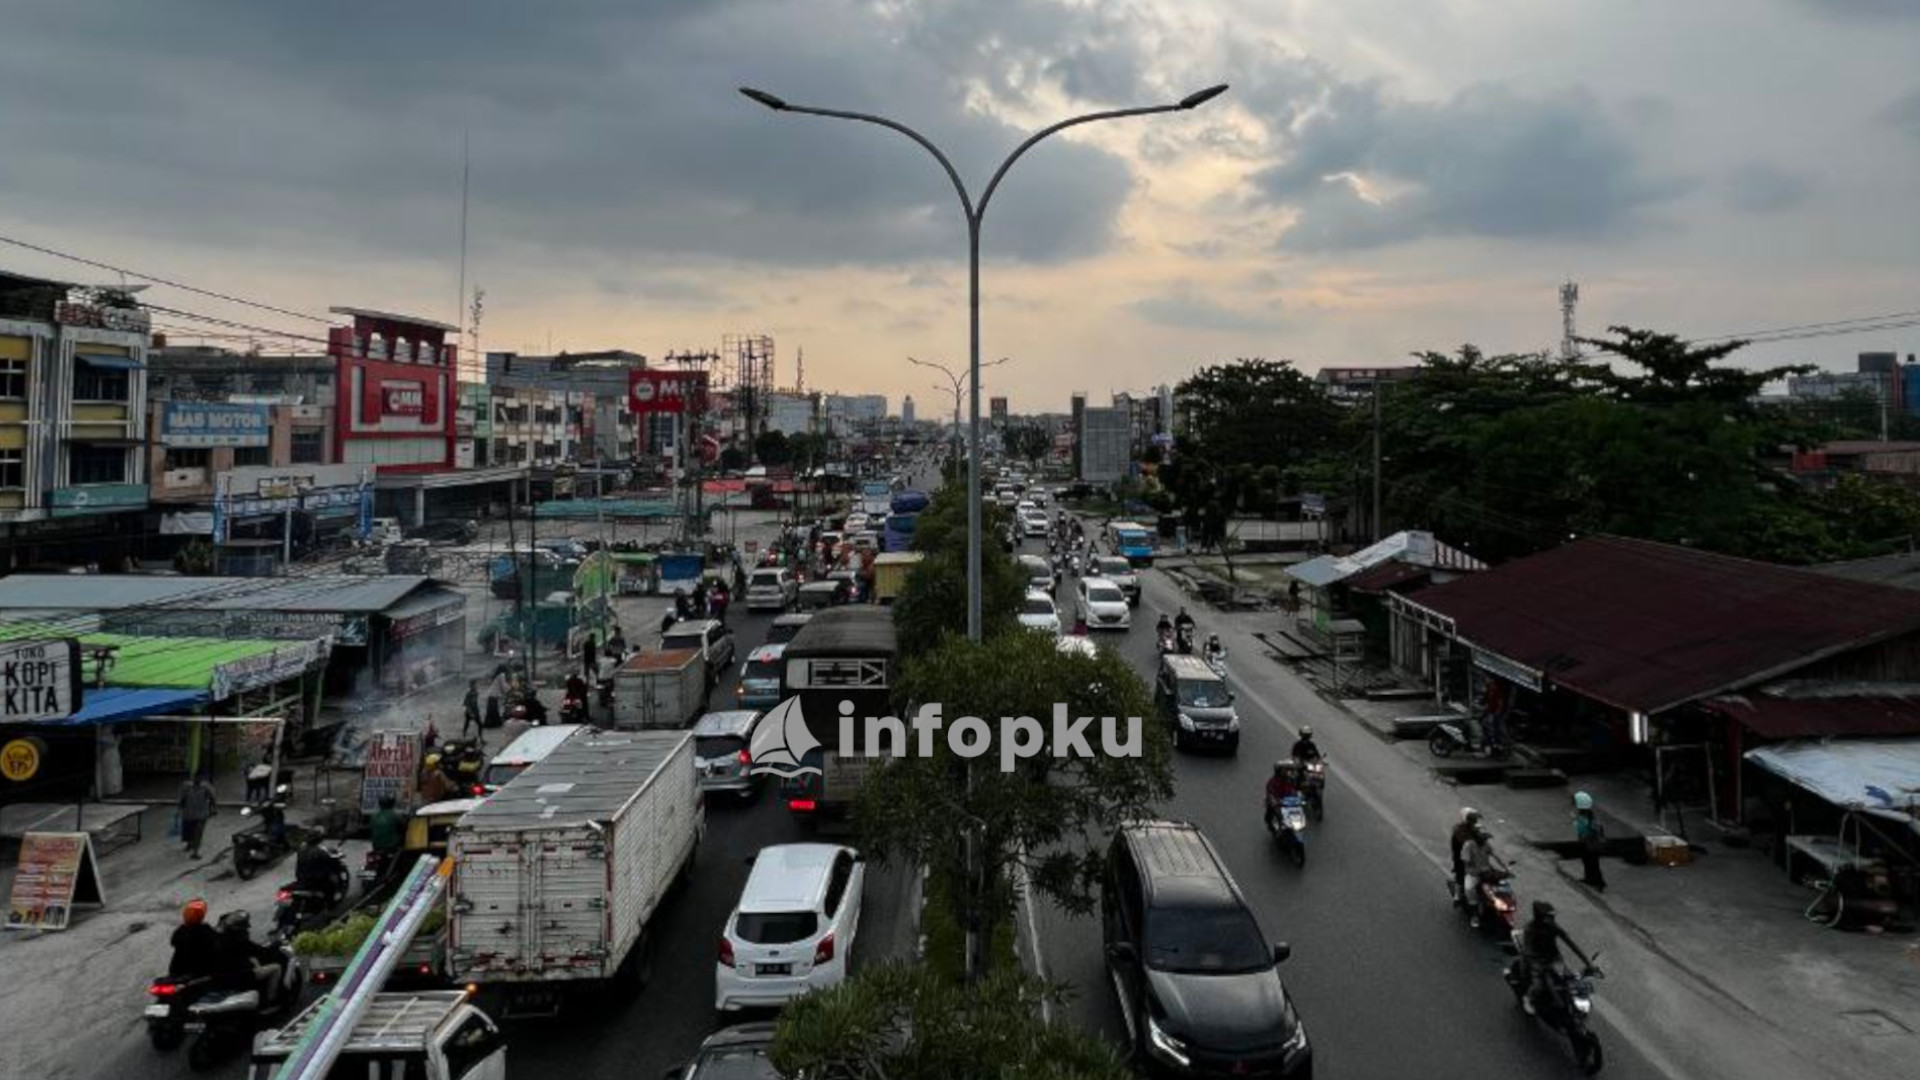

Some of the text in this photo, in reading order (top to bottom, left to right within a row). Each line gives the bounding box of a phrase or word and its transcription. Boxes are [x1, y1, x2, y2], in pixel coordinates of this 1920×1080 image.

[208, 412, 261, 428] MOTOR
[5, 661, 57, 686] KOPI
[5, 686, 58, 715] KITA
